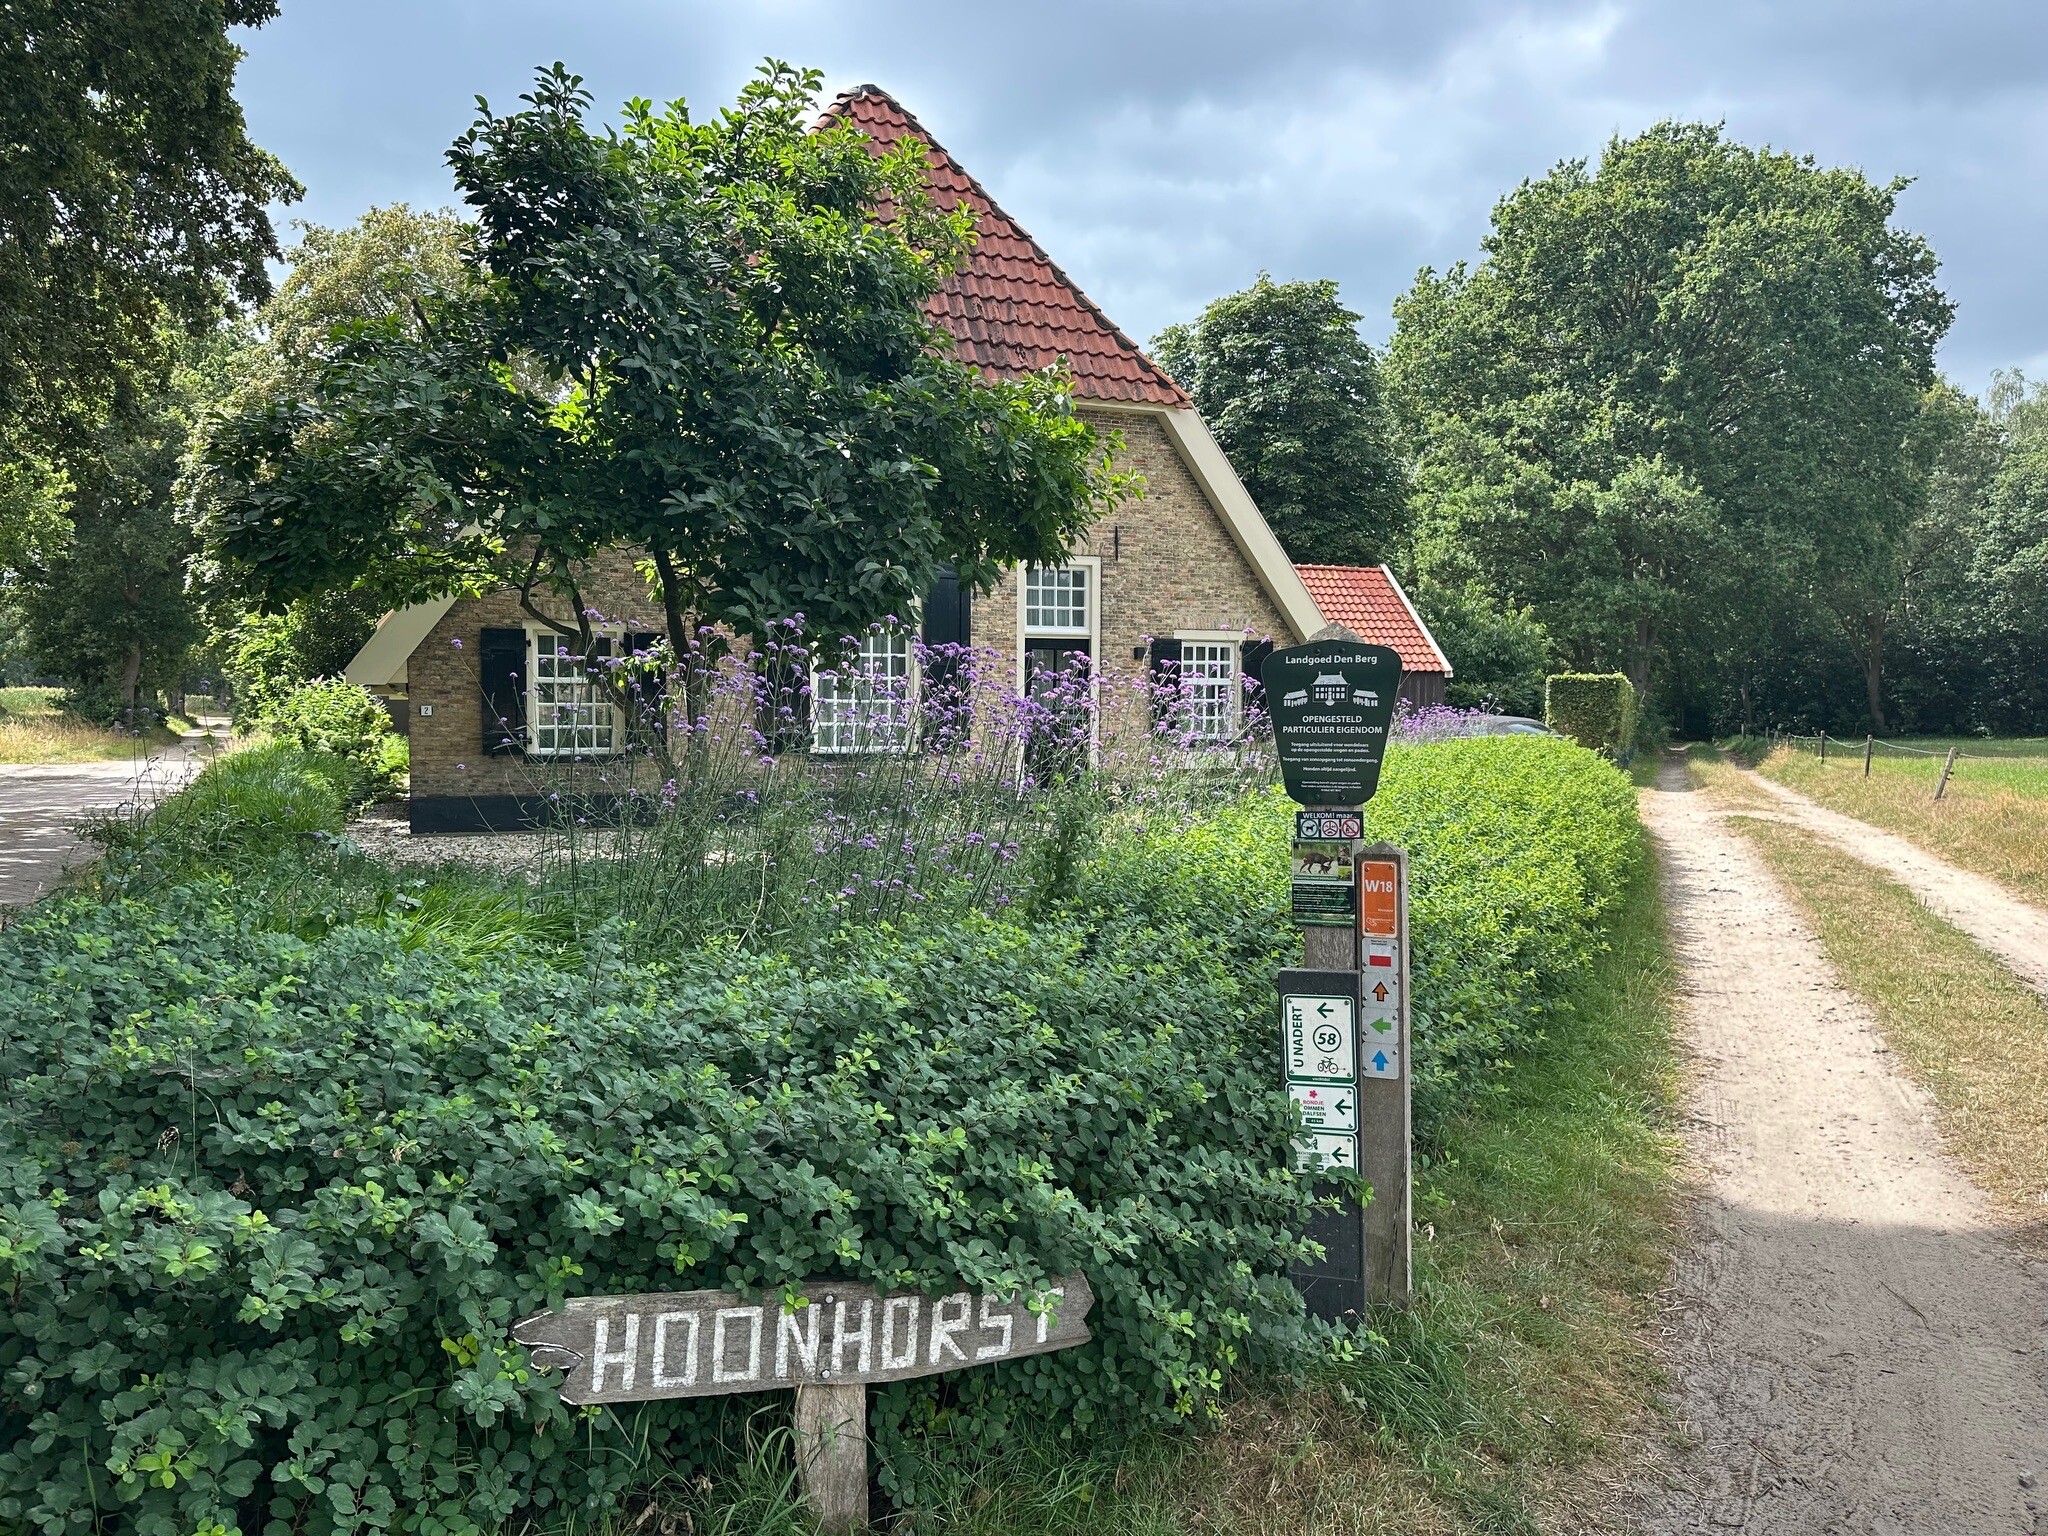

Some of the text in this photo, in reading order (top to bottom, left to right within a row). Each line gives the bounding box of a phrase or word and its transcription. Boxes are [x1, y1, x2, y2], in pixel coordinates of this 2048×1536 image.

[1285, 654, 1378, 666] Landgoed Den Berg
[423, 706, 429, 715] 2
[1302, 715, 1363, 723] OPENGESTELD
[1282, 725, 1383, 734] PARTICULIER EIGENDOM
[1365, 880, 1393, 893] W18
[1292, 1005, 1304, 1068] U NADERT
[1317, 1033, 1337, 1045] 58
[592, 1287, 1065, 1393] HOONHORST
